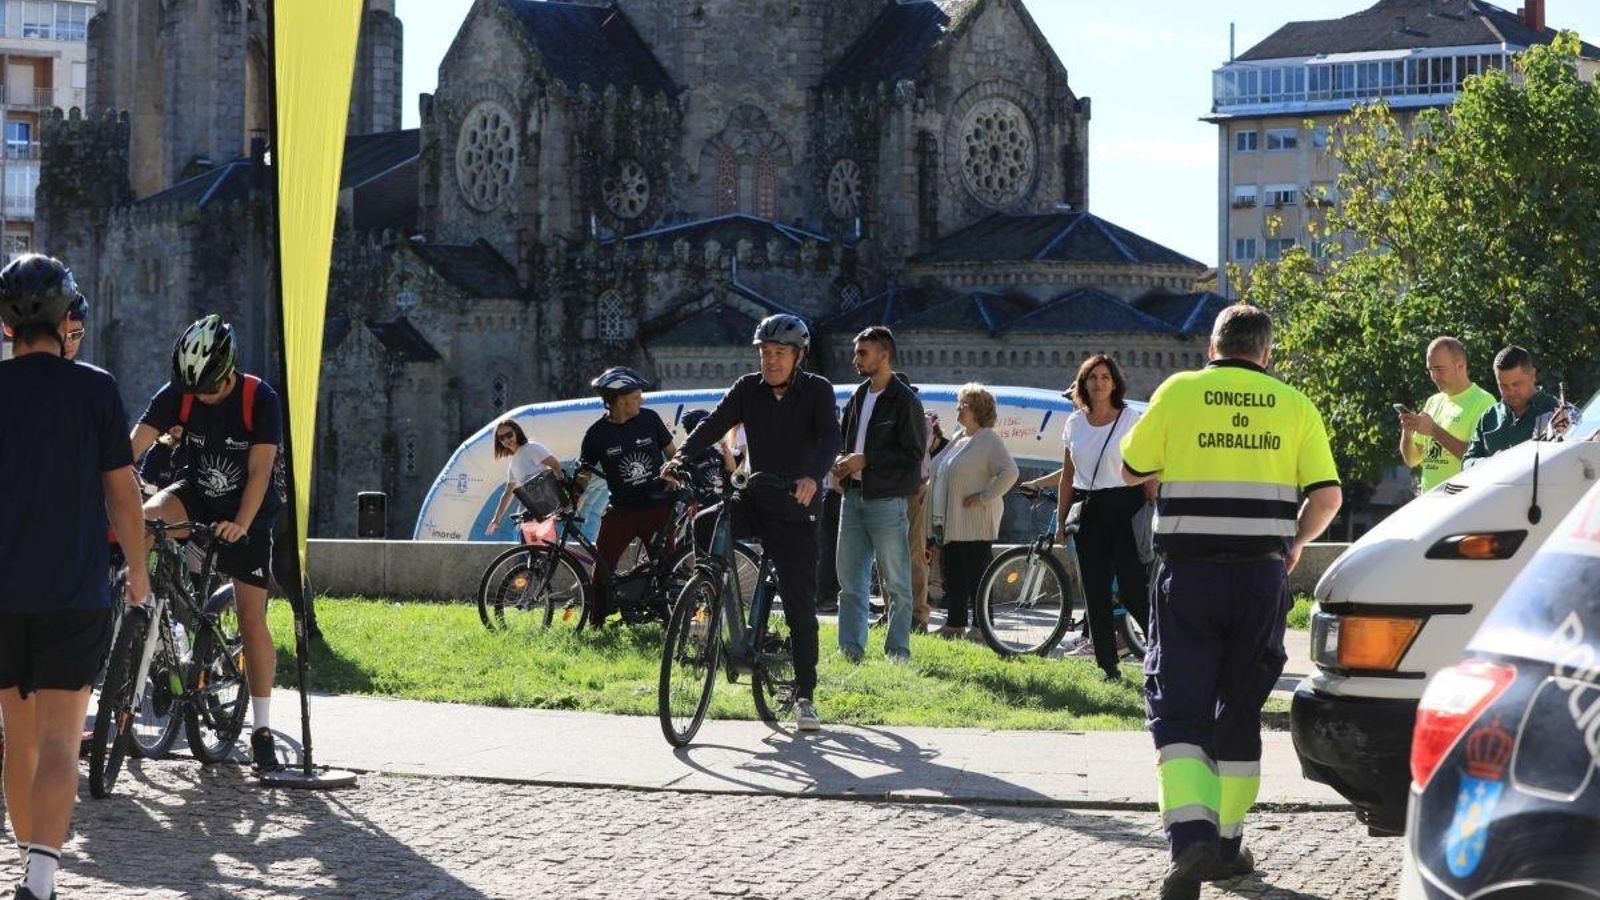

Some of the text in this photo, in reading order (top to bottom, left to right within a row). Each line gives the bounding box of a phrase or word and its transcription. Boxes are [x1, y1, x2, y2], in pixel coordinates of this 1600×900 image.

[1204, 390, 1276, 408] CONCELLO
[1232, 412, 1249, 427] do
[1198, 431, 1281, 450] CARBALLIÑO
